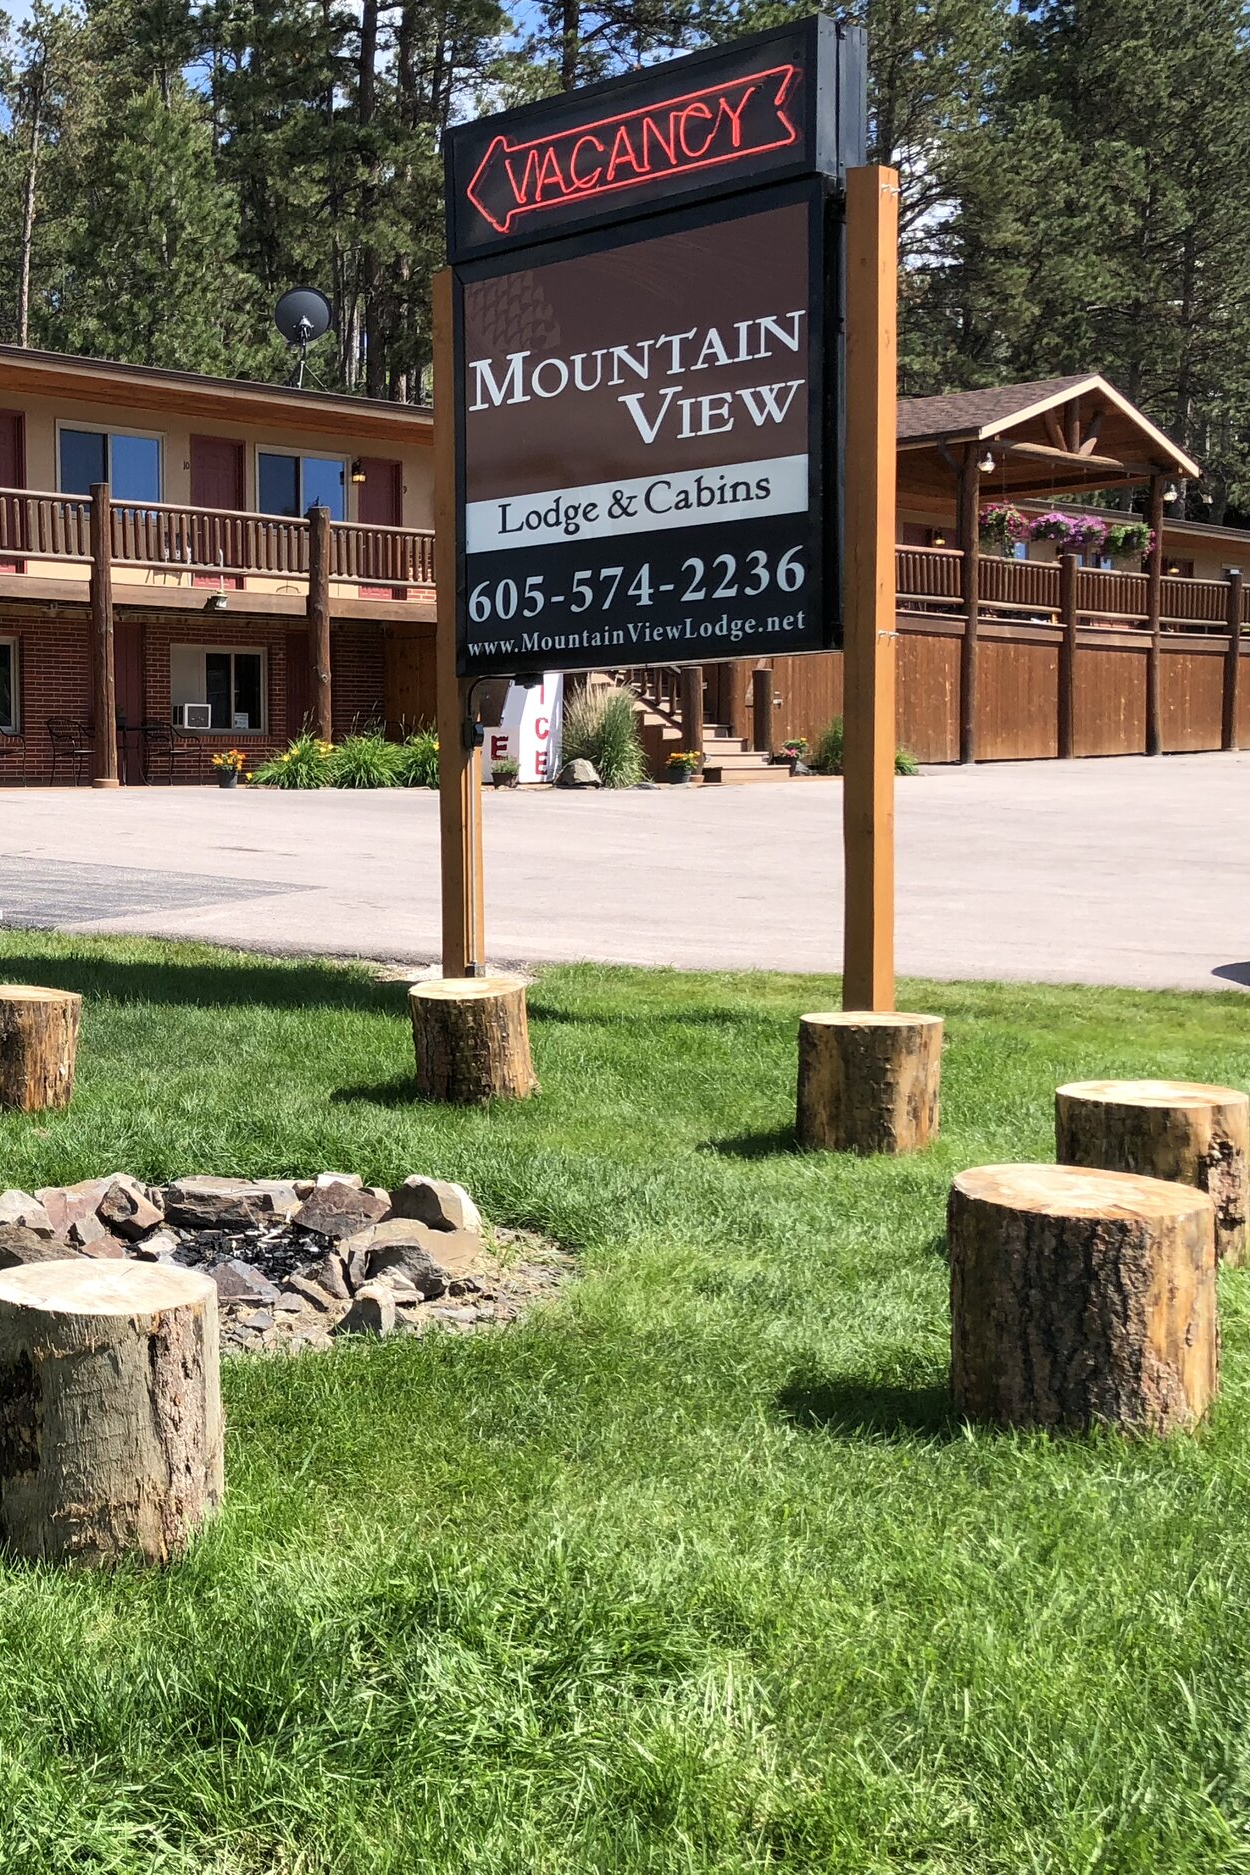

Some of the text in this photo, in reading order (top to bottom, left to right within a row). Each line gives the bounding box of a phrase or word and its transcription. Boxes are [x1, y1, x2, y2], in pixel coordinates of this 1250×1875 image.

[504, 86, 755, 204] VACANCY
[468, 309, 806, 412] MOUNTAIN
[617, 378, 806, 445] VIEW
[497, 474, 772, 536] Lodge & Cabins
[467, 544, 807, 623] 605-574-2236
[466, 609, 807, 658] www.MountainViewLodge.net
